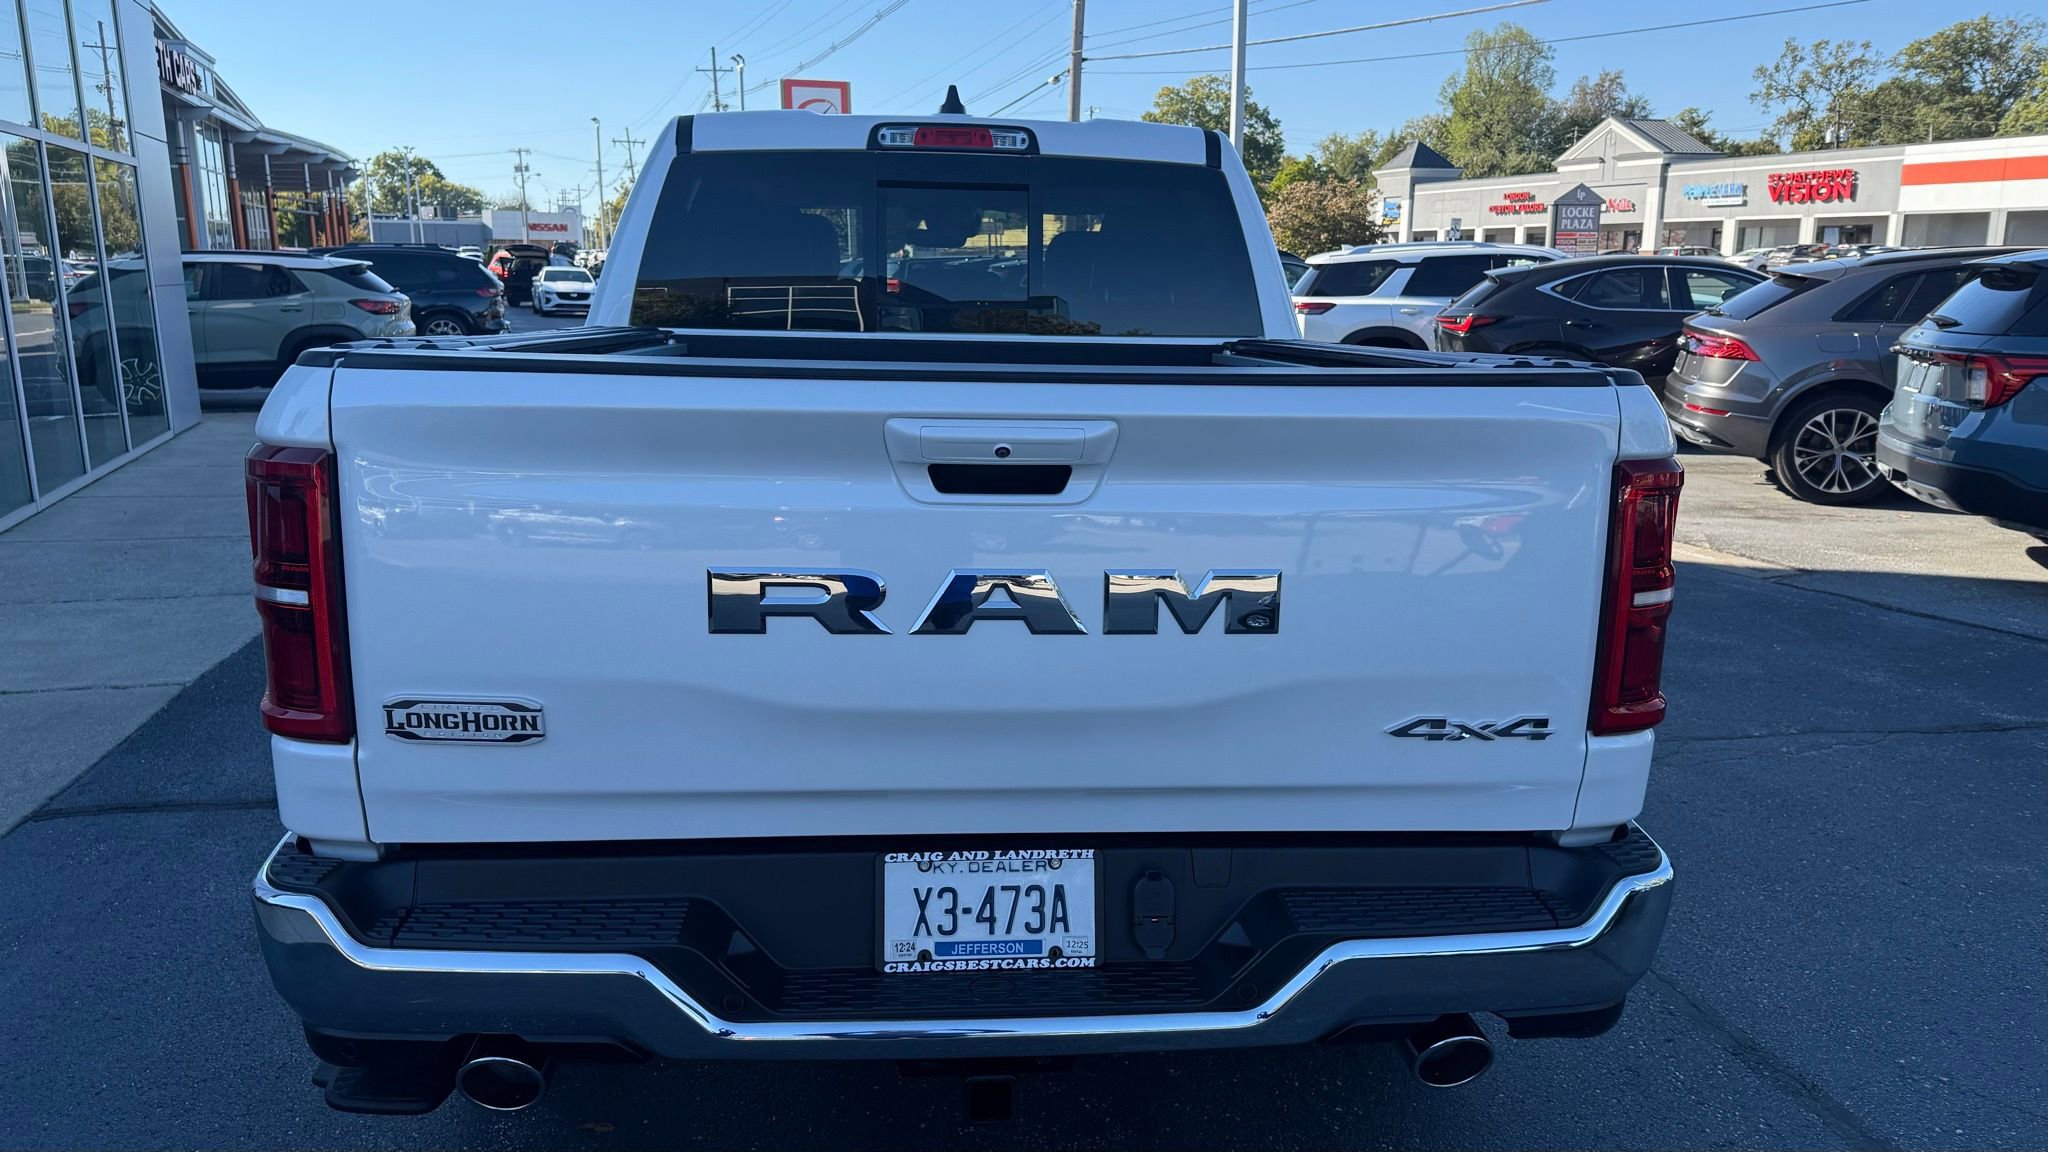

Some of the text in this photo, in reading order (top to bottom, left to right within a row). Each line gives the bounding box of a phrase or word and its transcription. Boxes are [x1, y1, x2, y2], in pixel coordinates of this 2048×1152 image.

[173, 50, 196, 96] CARS
[1504, 192, 1530, 200] LONDON
[1768, 180, 1853, 202] VISION
[1562, 207, 1595, 218] LOCKE
[528, 224, 568, 232] NISSAN
[1561, 219, 1594, 229] PLAZA
[707, 567, 1283, 635] RAM
[884, 849, 1095, 863] CRAIG AND LANDRETH
[932, 860, 1047, 874] KY. DEALER
[913, 884, 1070, 936] X3-473A
[951, 942, 1024, 955] JEFFERSON
[884, 957, 1096, 973] CRAIGSBESTCARS.COM
